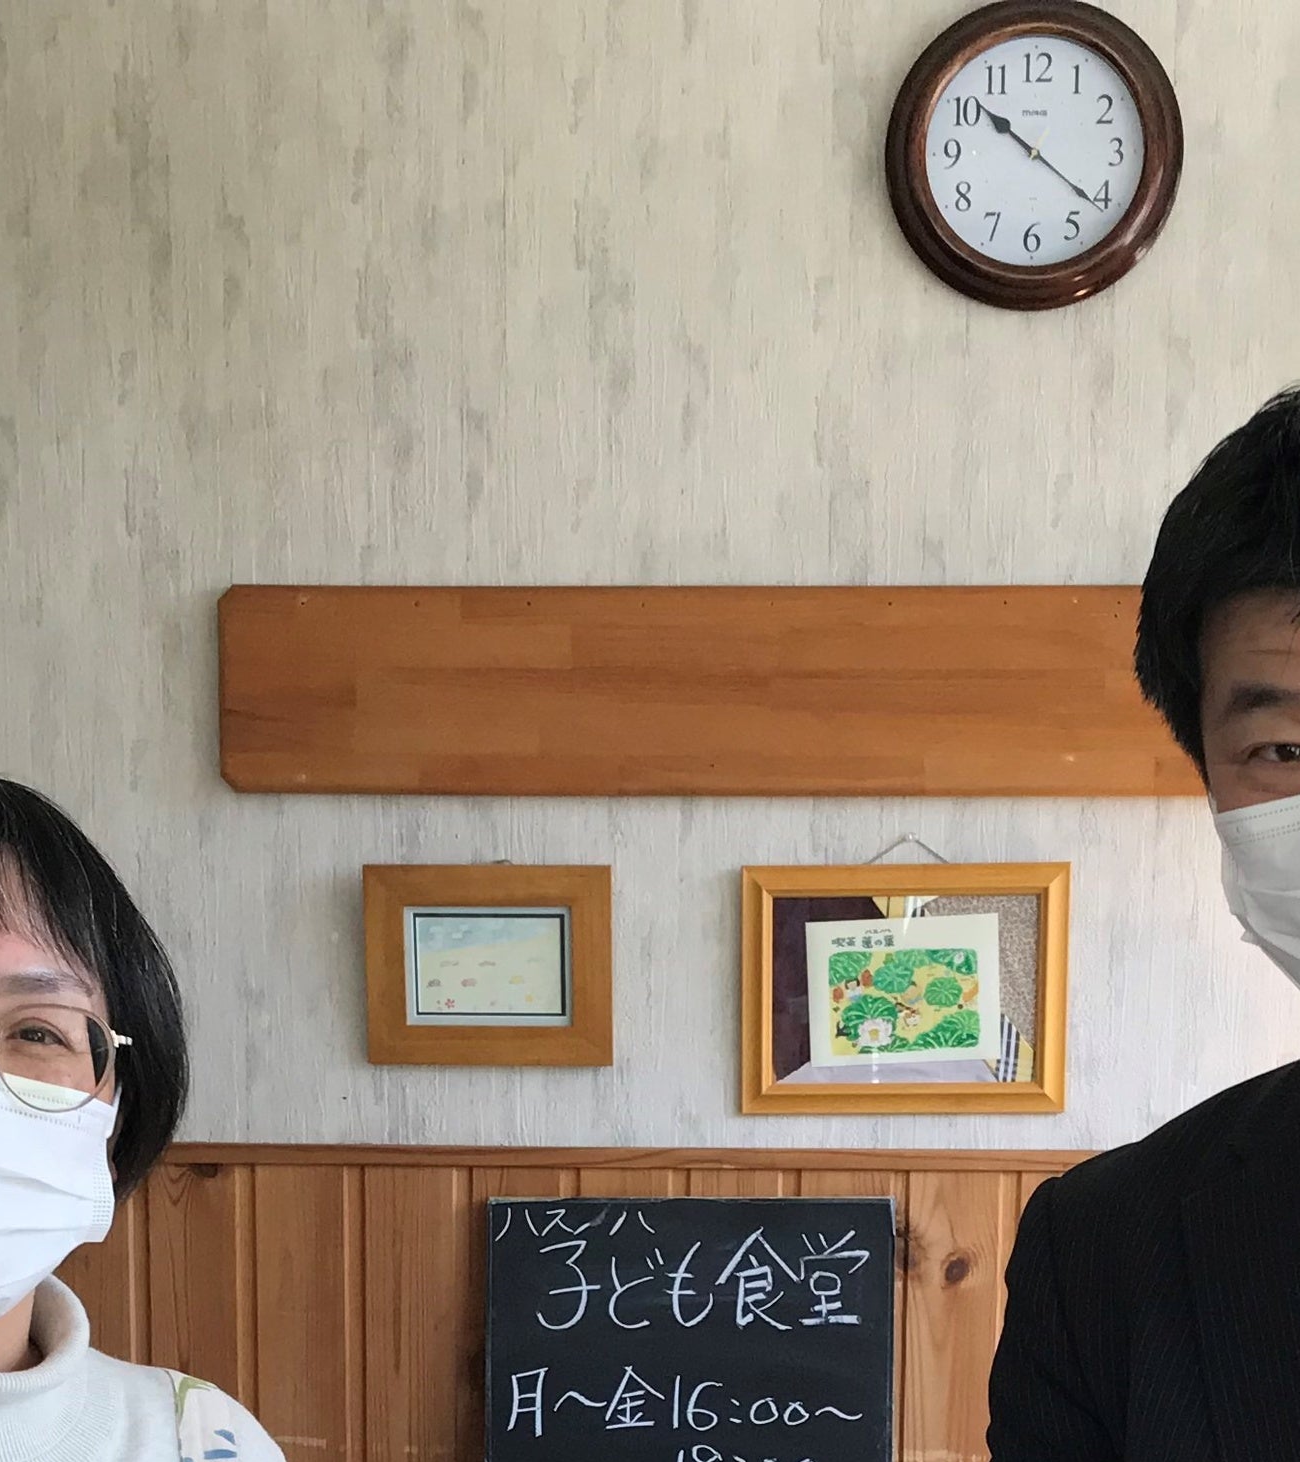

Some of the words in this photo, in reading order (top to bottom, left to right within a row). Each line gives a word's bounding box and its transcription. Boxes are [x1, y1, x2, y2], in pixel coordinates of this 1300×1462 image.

[986, 64, 1006, 95] 11
[1022, 52, 1053, 83] 12
[1072, 64, 1082, 94] 1
[953, 96, 981, 126] 10
[1096, 94, 1114, 125] 2
[943, 138, 962, 170] 9
[1108, 137, 1124, 167] 3
[954, 181, 972, 211] 8
[1093, 180, 1112, 209] 4
[984, 211, 1001, 242] 7
[1023, 222, 1041, 253] 6
[1064, 211, 1081, 241] 5
[536, 1225, 871, 1330] 子ども食堂
